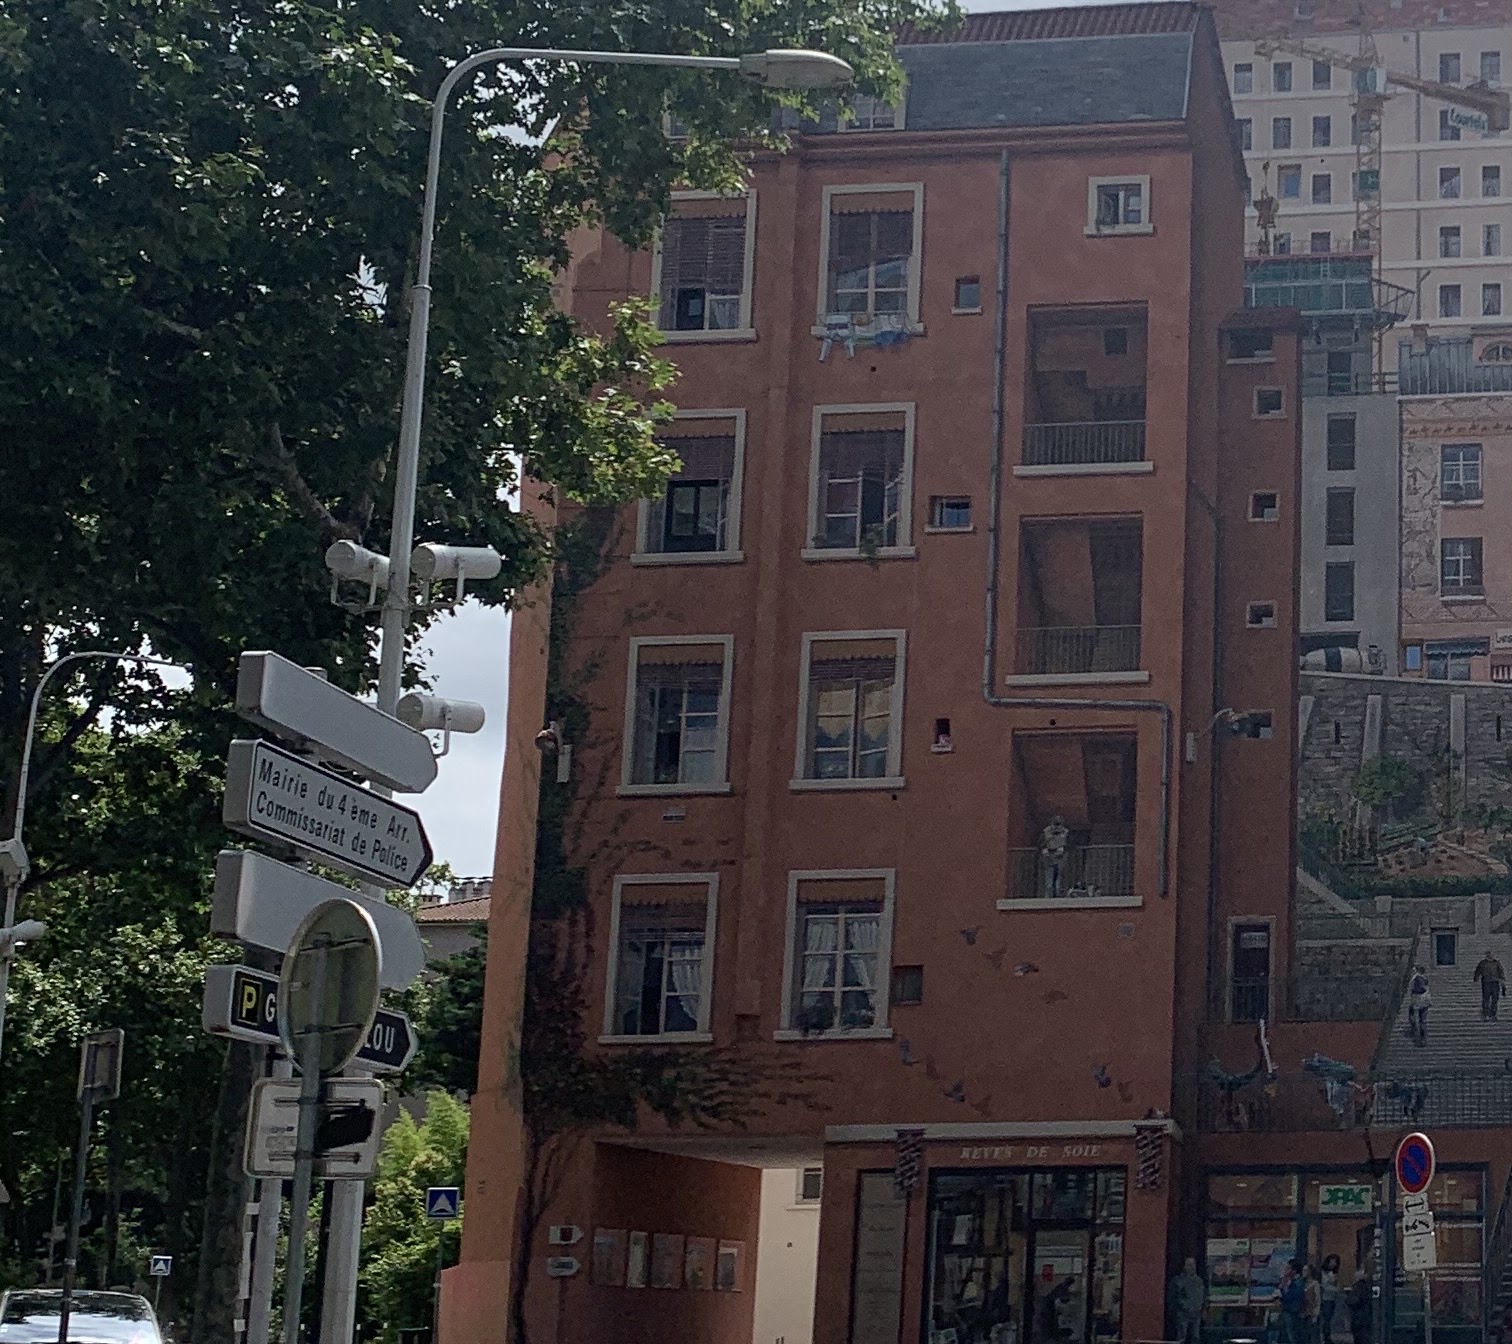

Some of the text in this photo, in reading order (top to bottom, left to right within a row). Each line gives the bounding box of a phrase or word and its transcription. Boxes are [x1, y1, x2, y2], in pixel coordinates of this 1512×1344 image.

[256, 791, 407, 871] Commissariat de Police
[258, 758, 308, 799] Mairie
[318, 786, 334, 809] du
[387, 815, 409, 844] Arr.
[241, 985, 257, 1018] P
